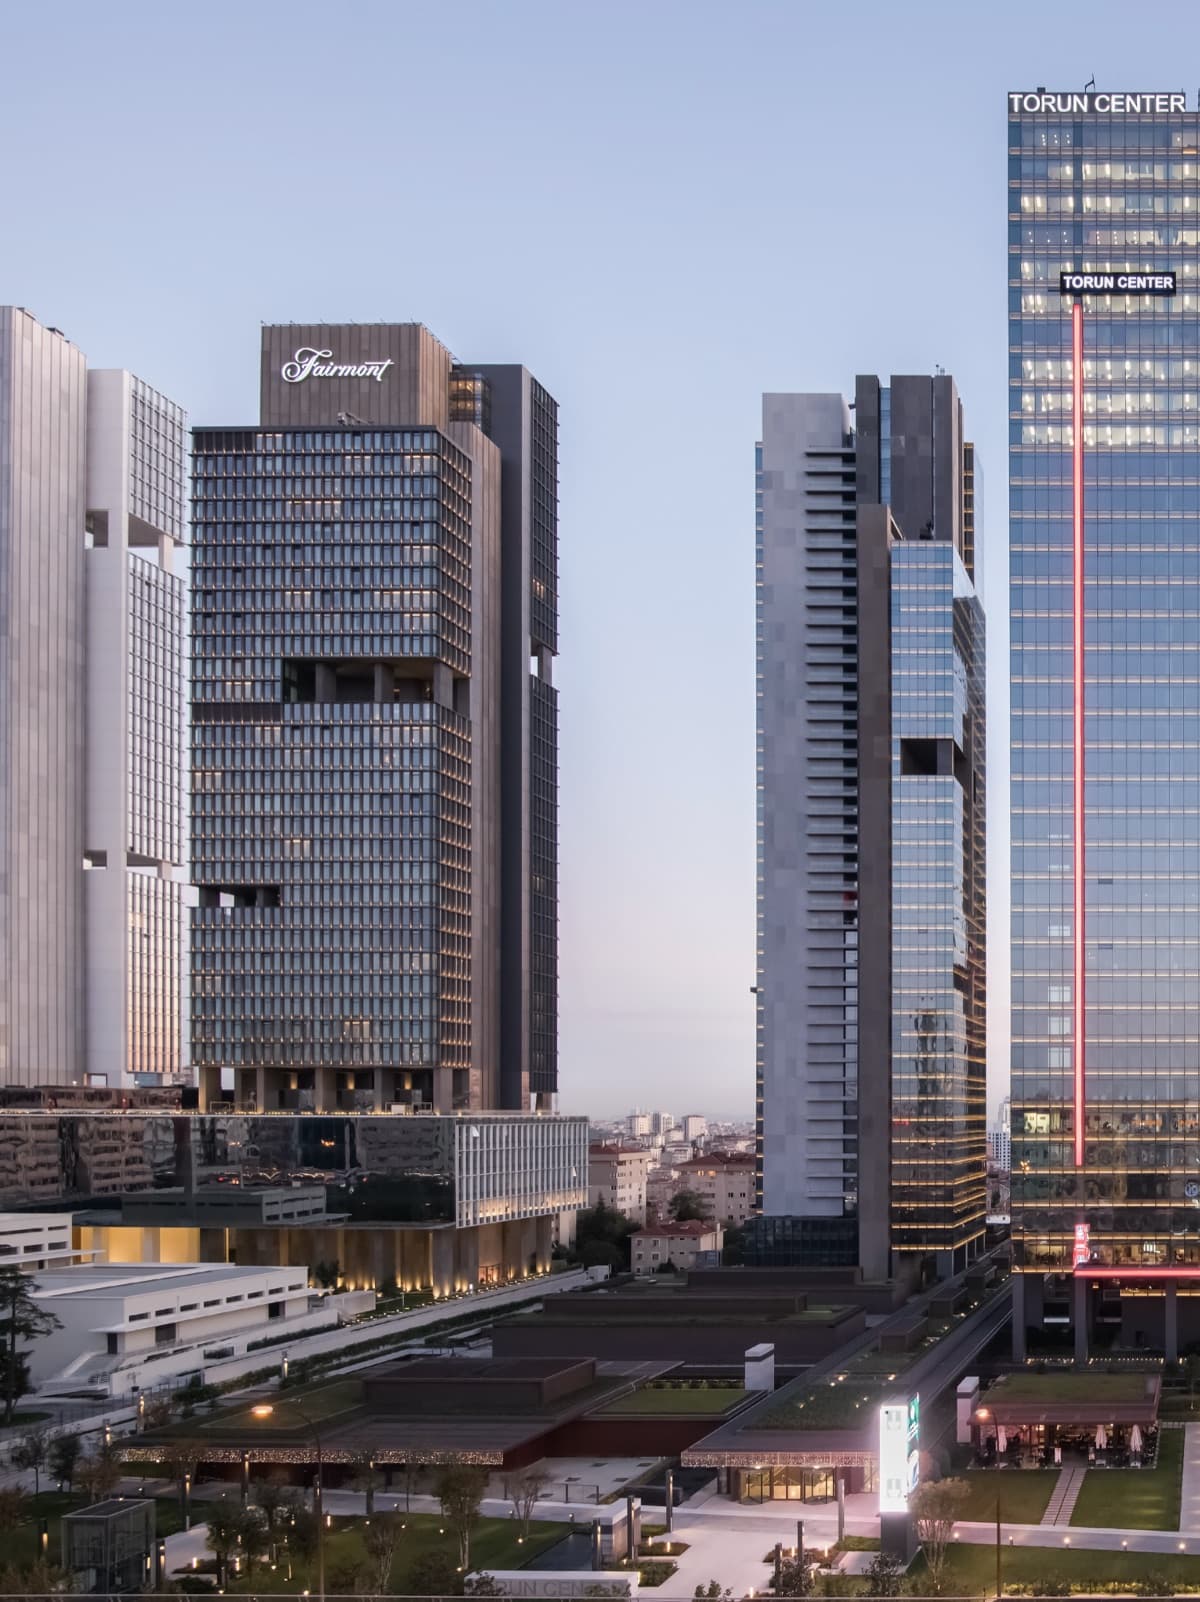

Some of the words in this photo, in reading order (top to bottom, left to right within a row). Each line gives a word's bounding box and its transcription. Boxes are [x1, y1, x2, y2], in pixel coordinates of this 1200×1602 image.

[1009, 94, 1088, 113] TORUN
[1094, 94, 1186, 113] CENTER
[1063, 276, 1114, 289] TORUN
[1117, 276, 1173, 289] CENTER
[281, 347, 395, 383] Fairmont
